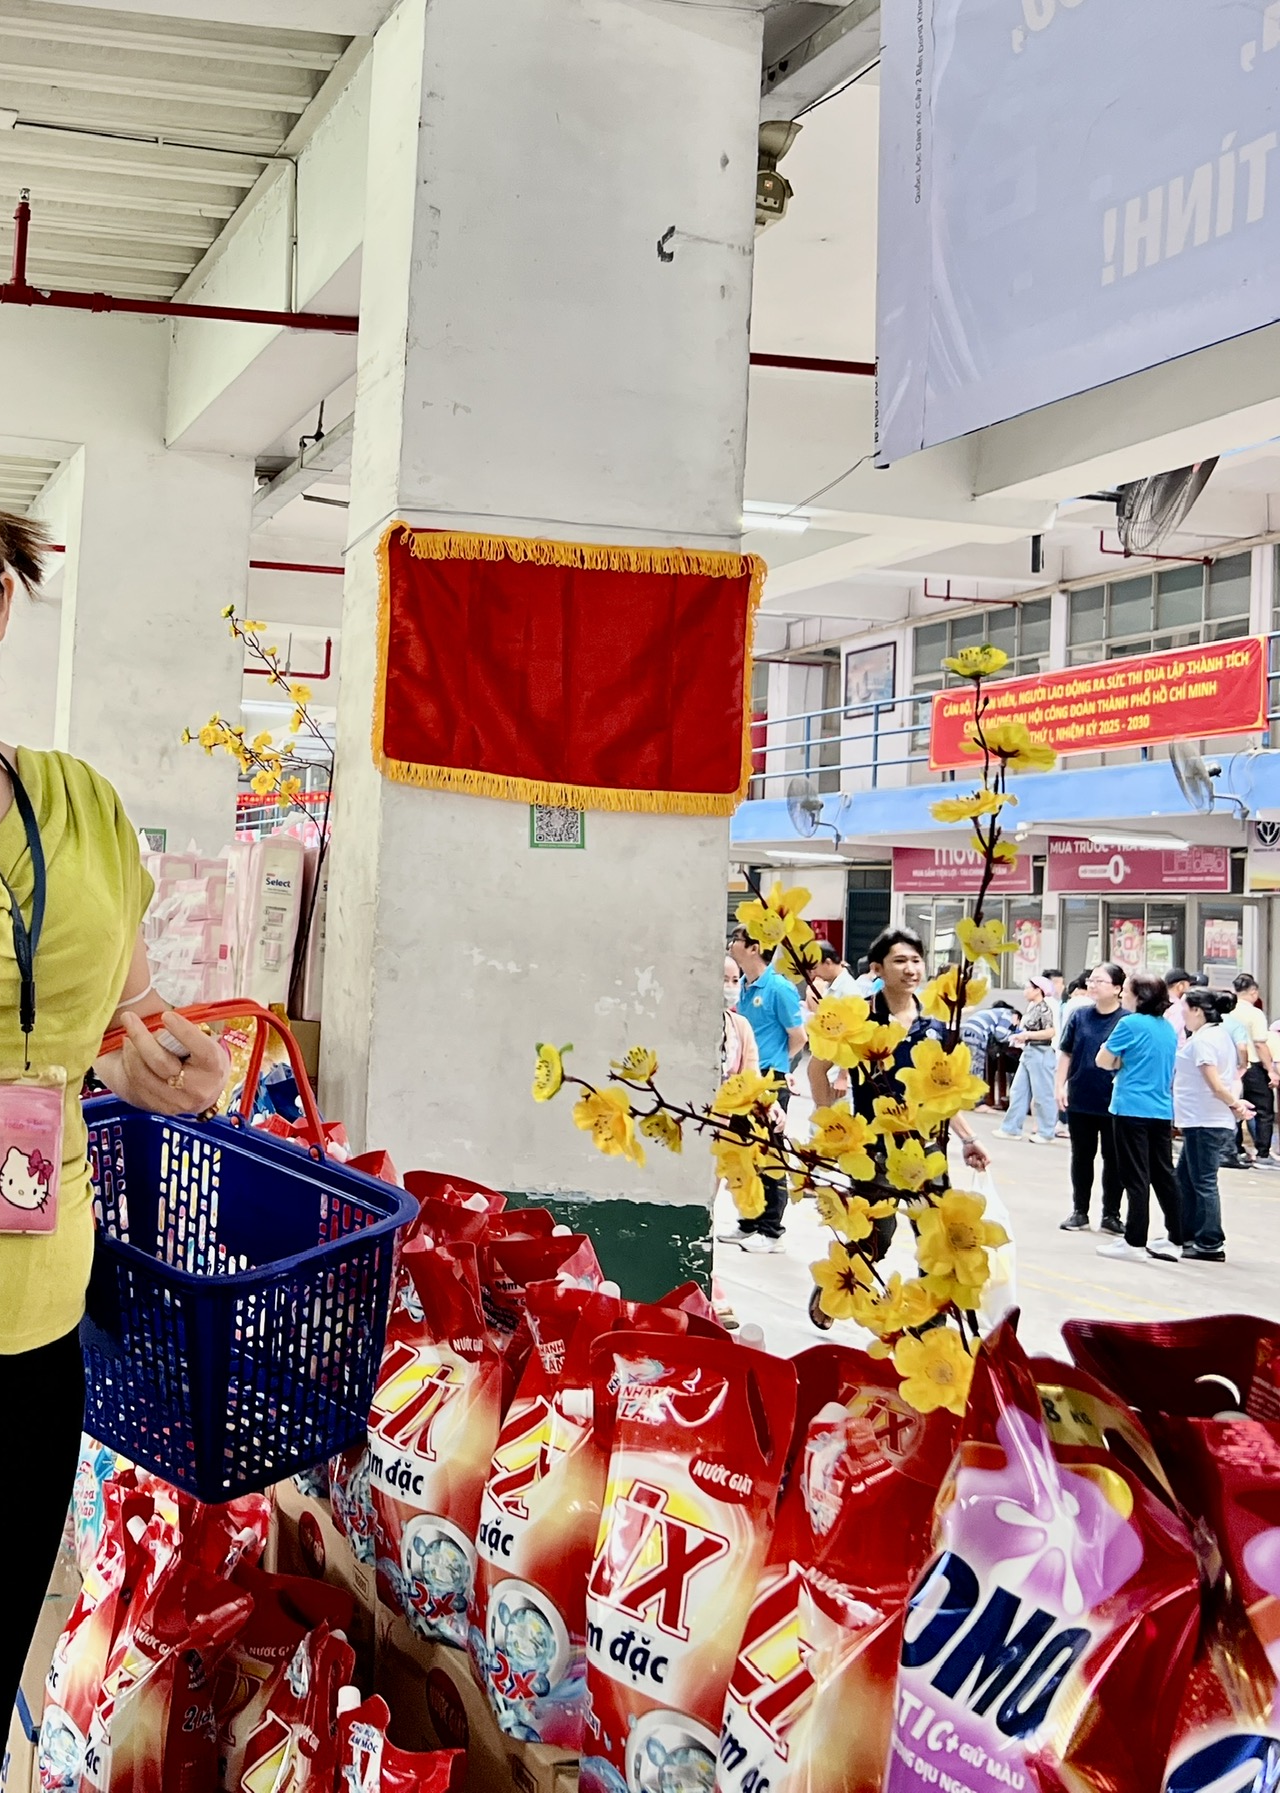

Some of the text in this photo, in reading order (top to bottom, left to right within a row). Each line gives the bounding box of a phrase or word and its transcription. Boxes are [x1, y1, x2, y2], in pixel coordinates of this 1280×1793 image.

[1044, 703, 1069, 721] CÔNG
[1070, 699, 1096, 718] ĐOÀN
[1097, 694, 1129, 714] THÀNH
[1170, 681, 1186, 702] CHÍ
[1188, 680, 1218, 699] MINH
[1048, 684, 1065, 700] LAO
[1065, 681, 1091, 699] ĐỘNG
[1127, 671, 1143, 686] THI
[1144, 666, 1166, 683] ĐUA
[1099, 717, 1120, 735] 2025
[1127, 714, 1151, 732] 2030
[1050, 841, 1071, 855] MUA
[265, 877, 291, 888] Select
[385, 1457, 425, 1496] đặc
[692, 1459, 754, 1498] NƯỚC GIẶT
[609, 1630, 669, 1684] đặc
